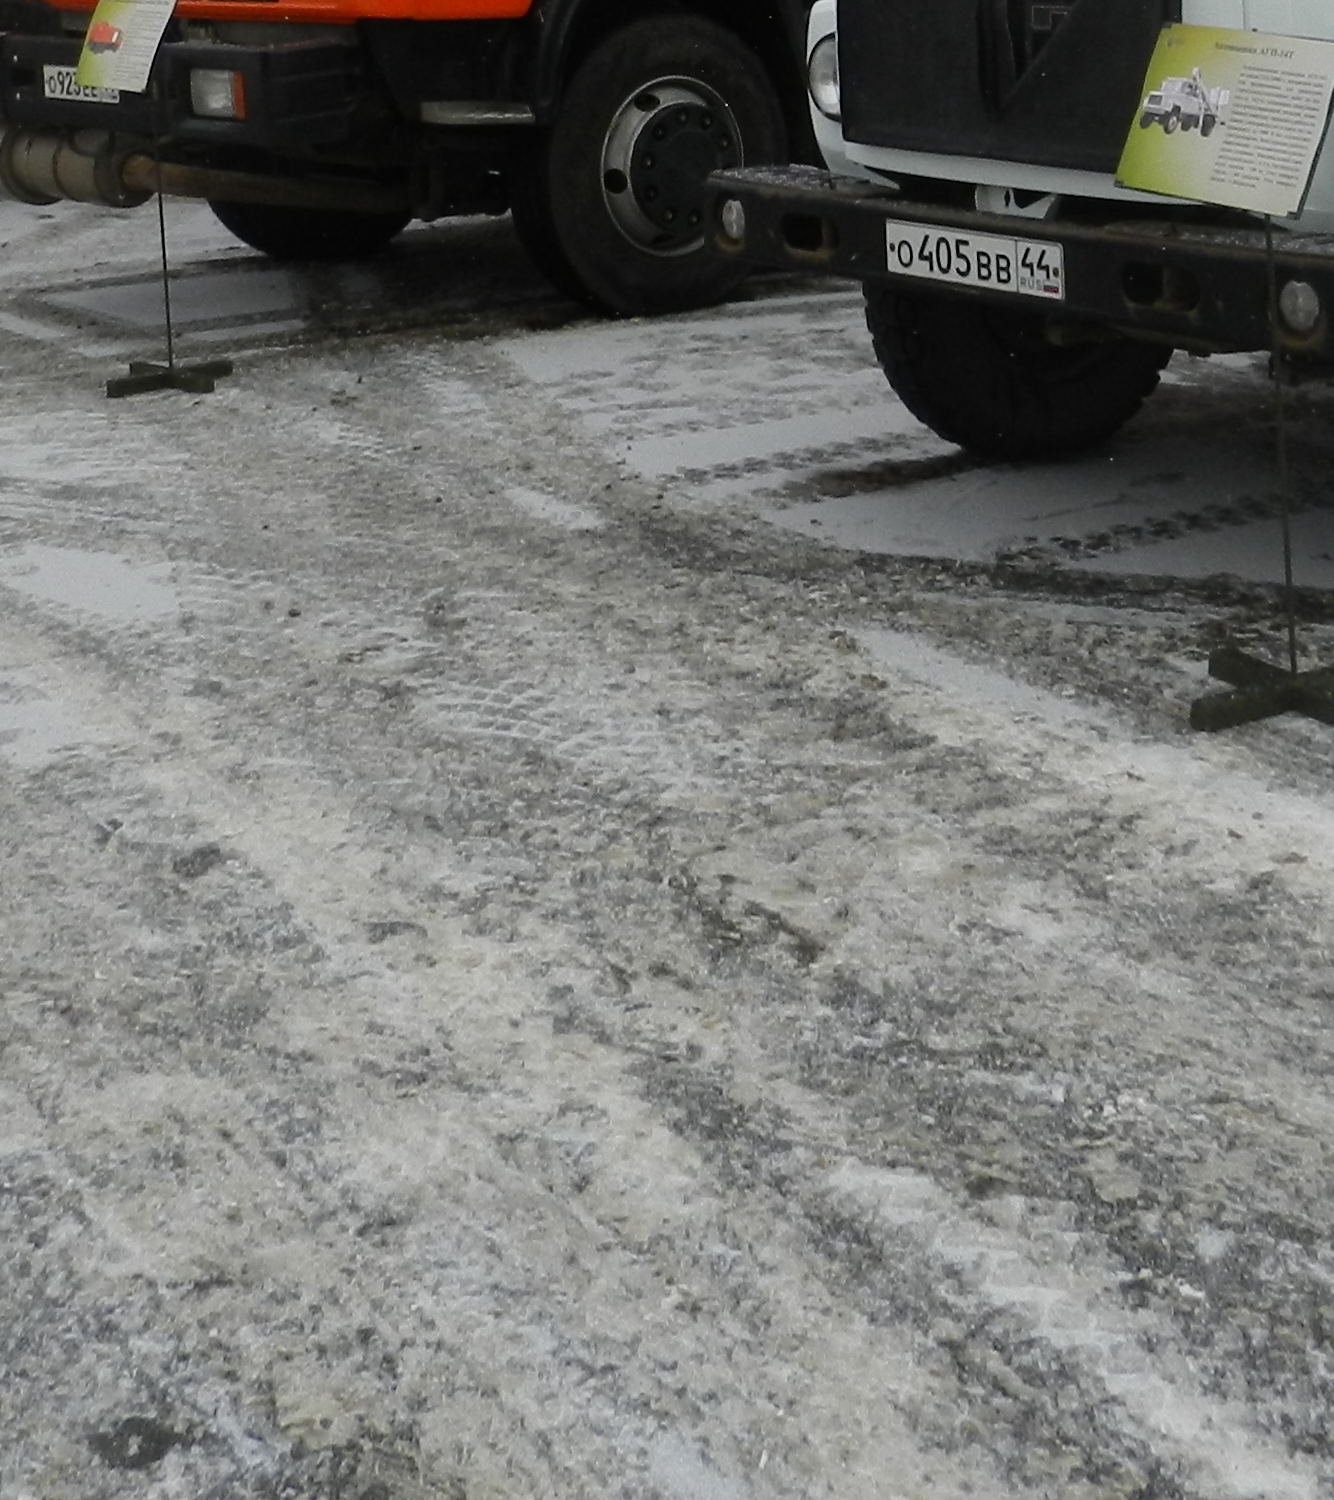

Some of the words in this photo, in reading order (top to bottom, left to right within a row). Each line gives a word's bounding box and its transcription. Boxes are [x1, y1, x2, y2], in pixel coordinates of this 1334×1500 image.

[897, 234, 1012, 284] О405ВВ
[1021, 247, 1051, 280] 44
[1020, 276, 1043, 292] RUS
